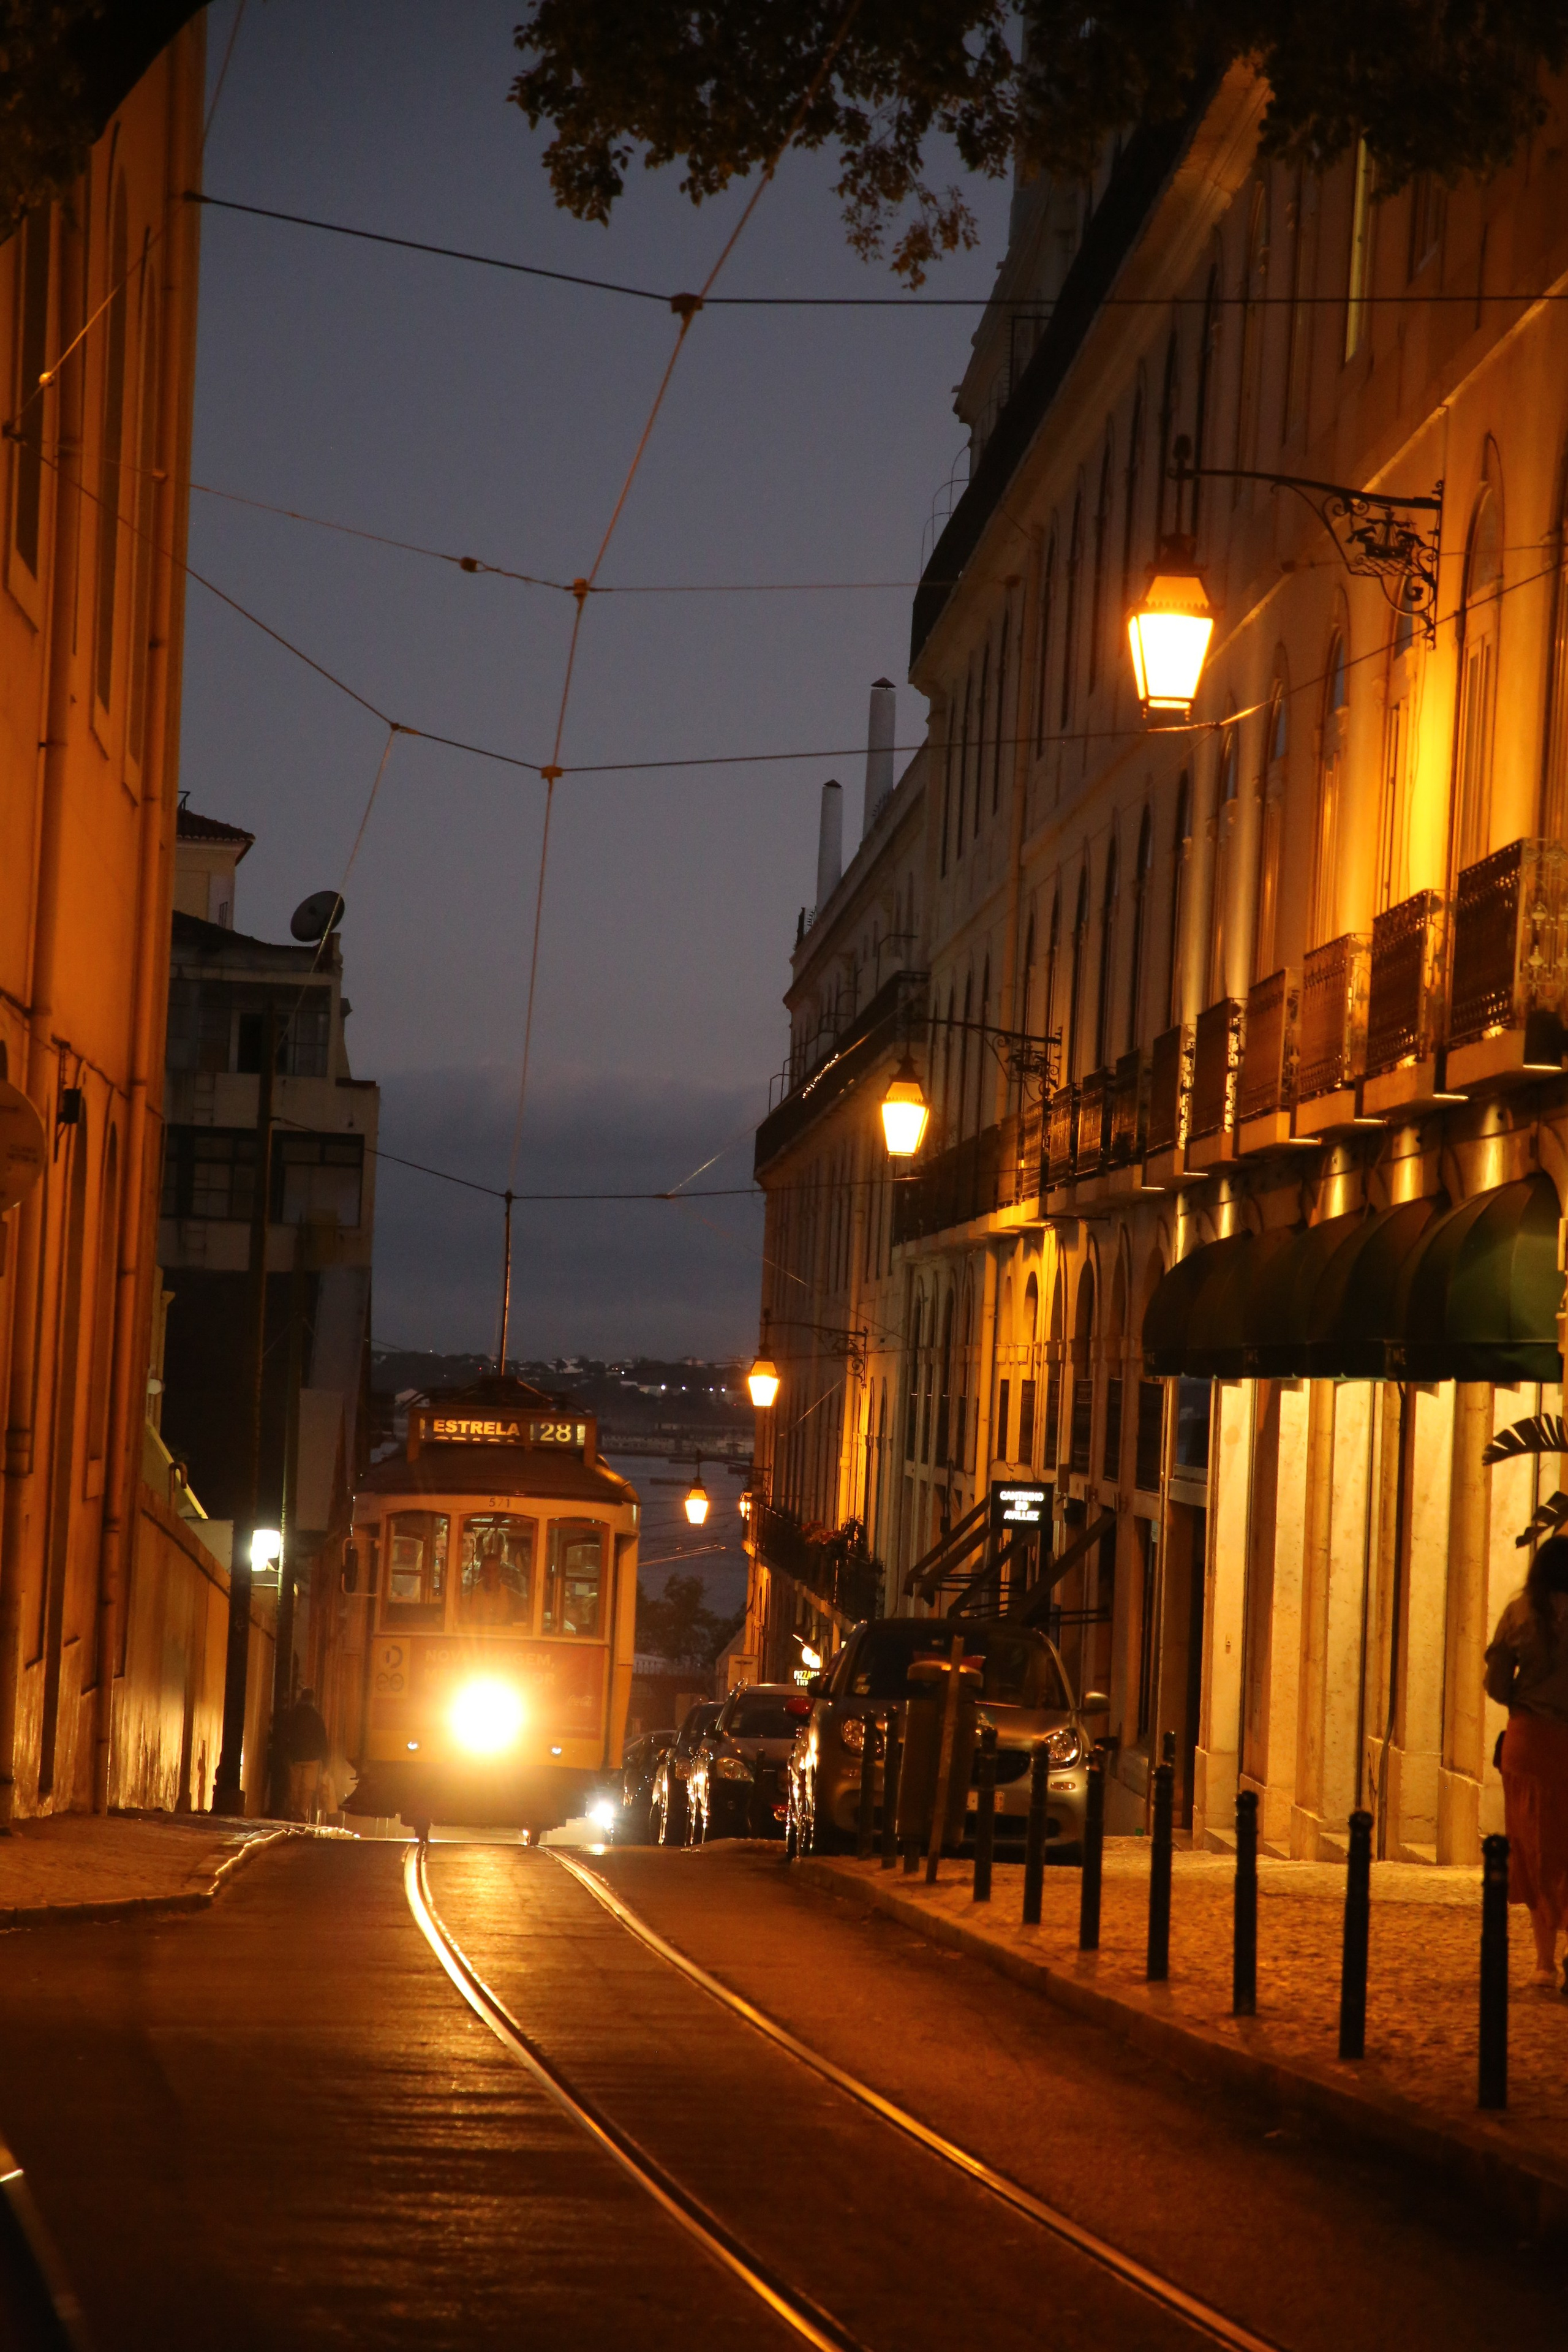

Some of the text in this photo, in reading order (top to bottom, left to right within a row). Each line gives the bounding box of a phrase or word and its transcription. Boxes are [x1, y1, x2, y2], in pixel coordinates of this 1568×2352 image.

[433, 1419, 572, 1442] ESTRELA 28
[489, 1498, 510, 1508] 571
[1014, 1501, 1029, 1511] DO
